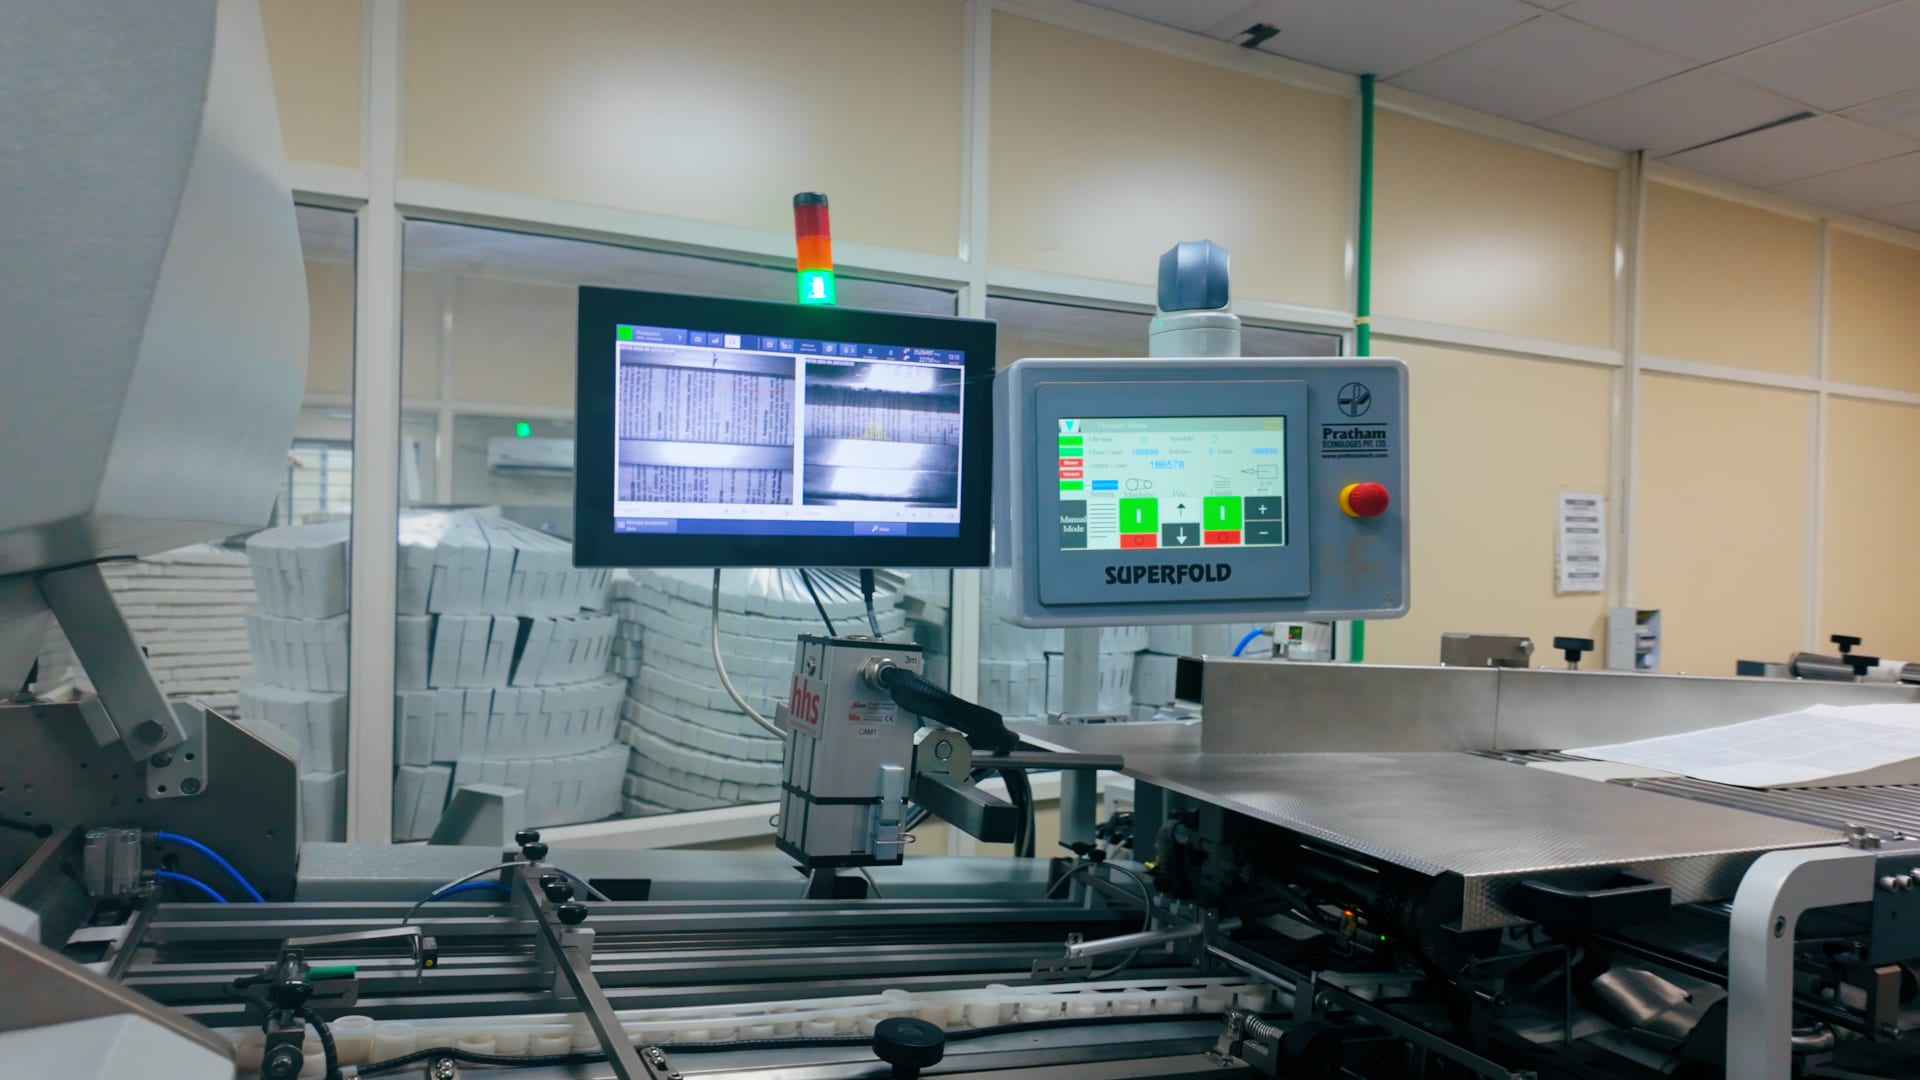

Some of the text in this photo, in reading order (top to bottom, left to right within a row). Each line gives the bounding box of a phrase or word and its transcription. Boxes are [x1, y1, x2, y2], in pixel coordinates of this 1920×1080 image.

[1323, 427, 1387, 439] Pratham
[1322, 440, 1362, 449] TECHNOLOGIES
[1149, 460, 1185, 470] 186578
[1060, 516, 1087, 525] Manual
[1063, 525, 1085, 533] Mode
[1105, 563, 1232, 585] SUPERFOLD
[904, 655, 917, 664] 3m
[790, 675, 821, 725] hhs
